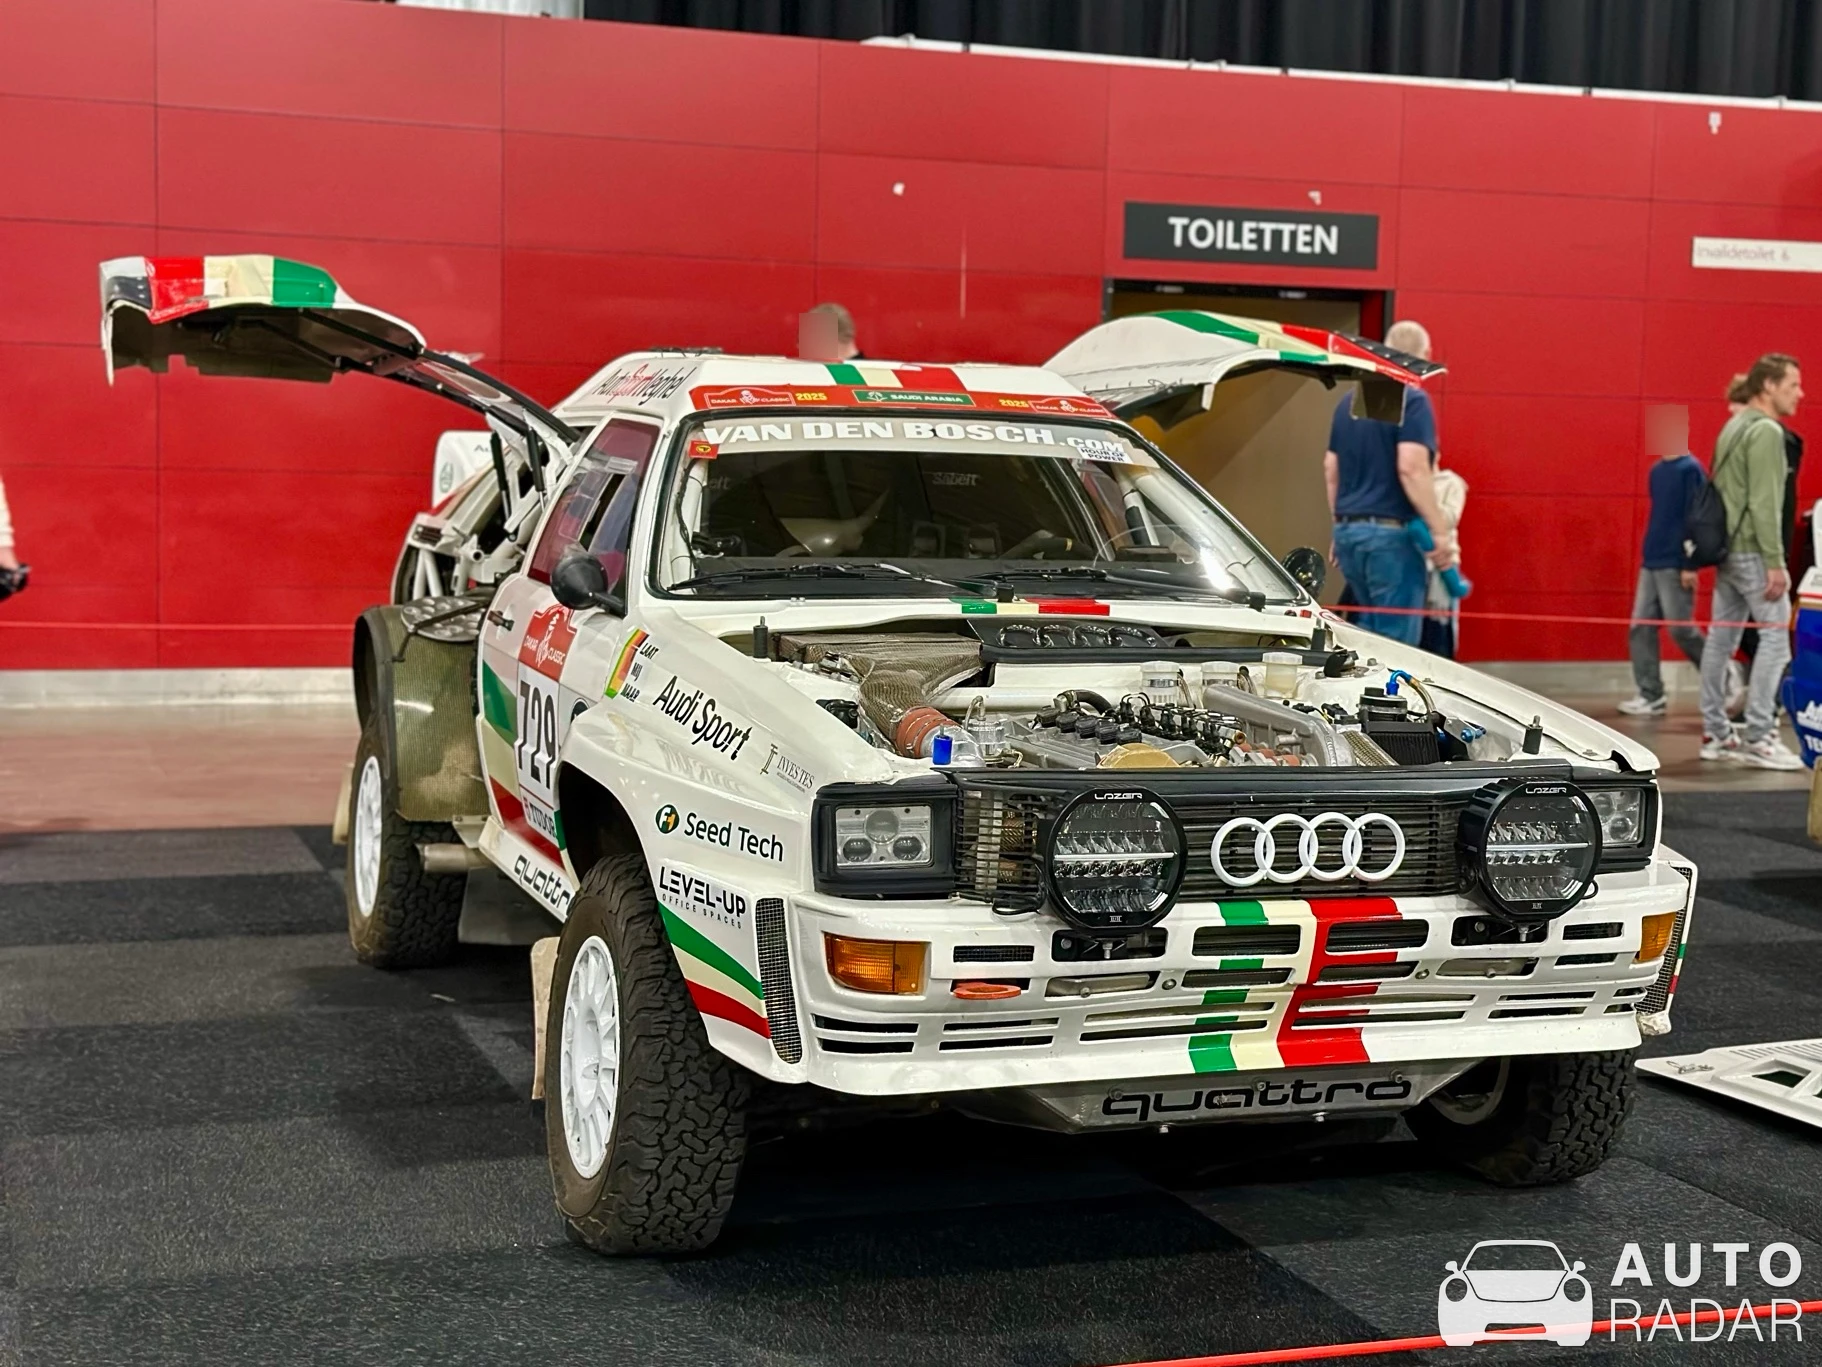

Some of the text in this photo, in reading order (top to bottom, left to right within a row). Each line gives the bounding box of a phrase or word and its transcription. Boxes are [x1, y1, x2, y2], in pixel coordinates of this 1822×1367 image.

[1167, 216, 1339, 255] TOILETTEN
[795, 392, 828, 401] 2025
[889, 393, 964, 403] SAUDI ARABIA
[703, 423, 793, 445] VAN
[803, 421, 894, 440] DEN
[1080, 447, 1125, 458] HOUR OF
[1087, 453, 1125, 462] POWER
[640, 642, 660, 660] LAAT
[630, 662, 644, 682] MIJ
[620, 682, 641, 703] MAAR
[652, 675, 753, 761] Audi Sport
[517, 680, 557, 790] 729
[1094, 792, 1143, 800] LAZER
[1525, 786, 1567, 794] LAZER
[528, 802, 558, 838] TUDOR
[684, 811, 733, 848] Seed
[737, 825, 784, 862] Tech
[658, 865, 747, 918] LEVEL-UP
[661, 893, 743, 930] OFFICE SPACES
[1101, 1078, 1412, 1122] quattro
